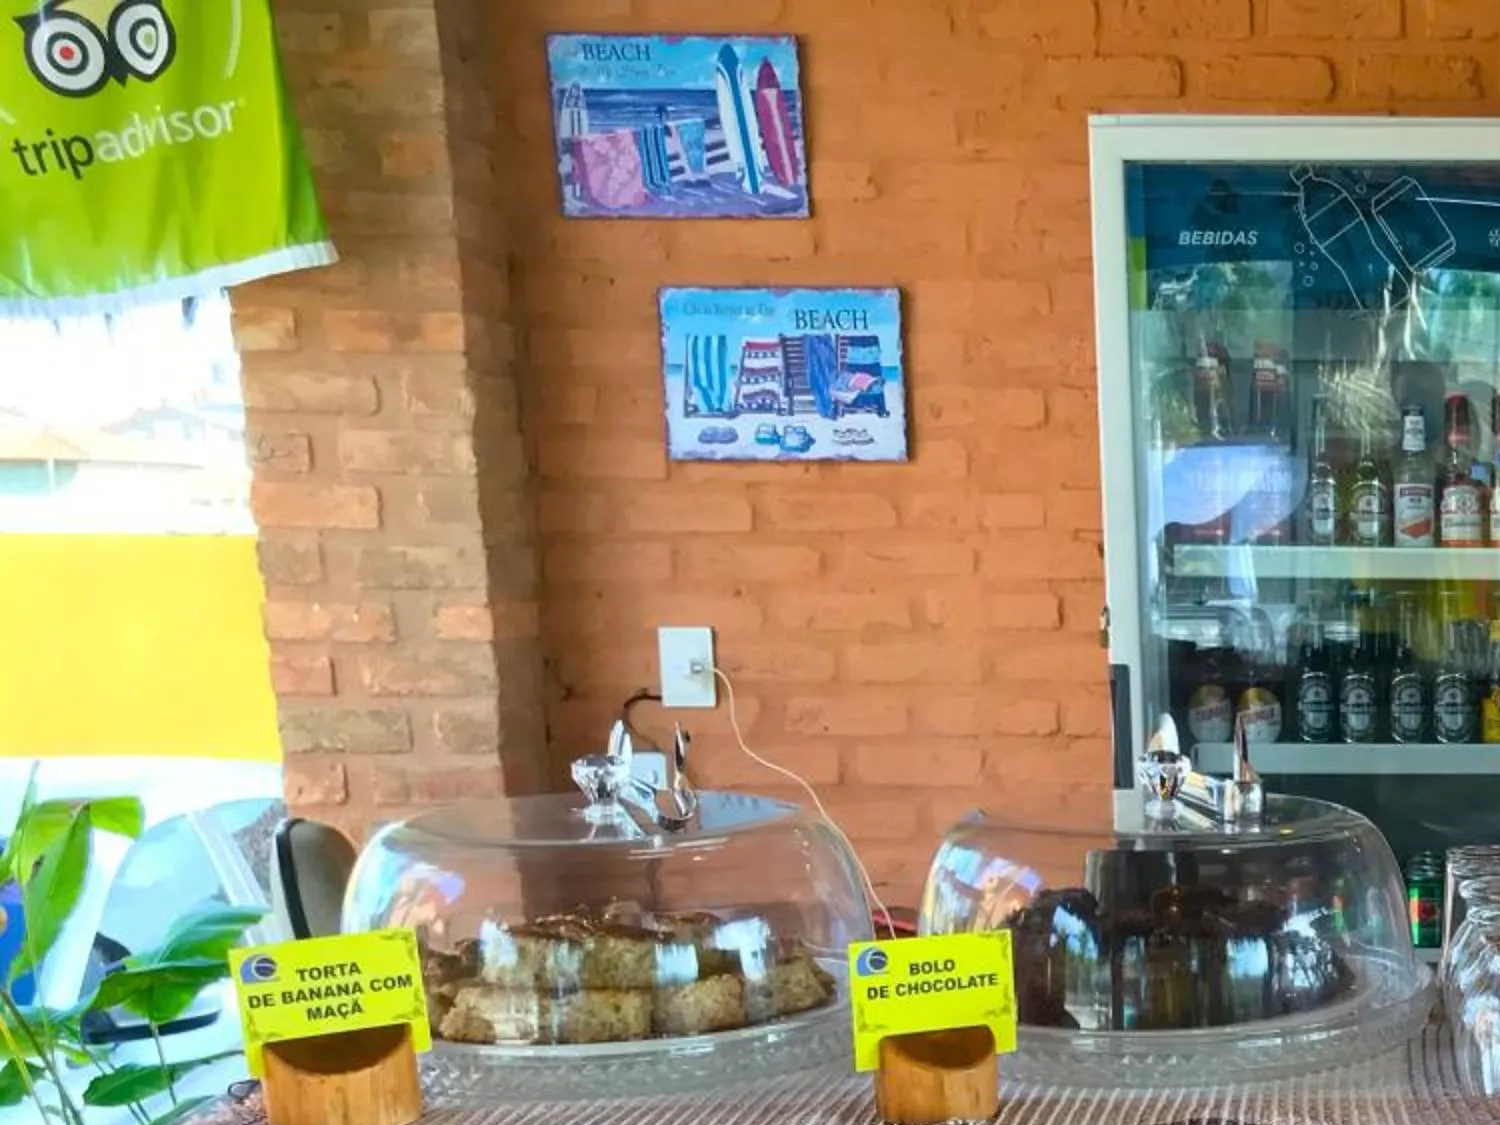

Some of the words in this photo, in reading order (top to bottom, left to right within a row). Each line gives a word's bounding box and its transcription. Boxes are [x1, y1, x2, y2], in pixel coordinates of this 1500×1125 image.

[581, 43, 651, 61] BEACH
[12, 98, 236, 180] tripadvisor
[1178, 230, 1258, 246] BEBIDAS
[795, 309, 867, 330] BEACH
[295, 962, 361, 983] TORTA
[909, 959, 956, 976] BOLO
[247, 993, 276, 1009] DE
[280, 980, 364, 1005] BANANA
[369, 974, 413, 992] COM
[867, 985, 890, 1000] DE
[895, 973, 998, 997] CHOCOLATE
[306, 998, 363, 1021] MAÇÃ
